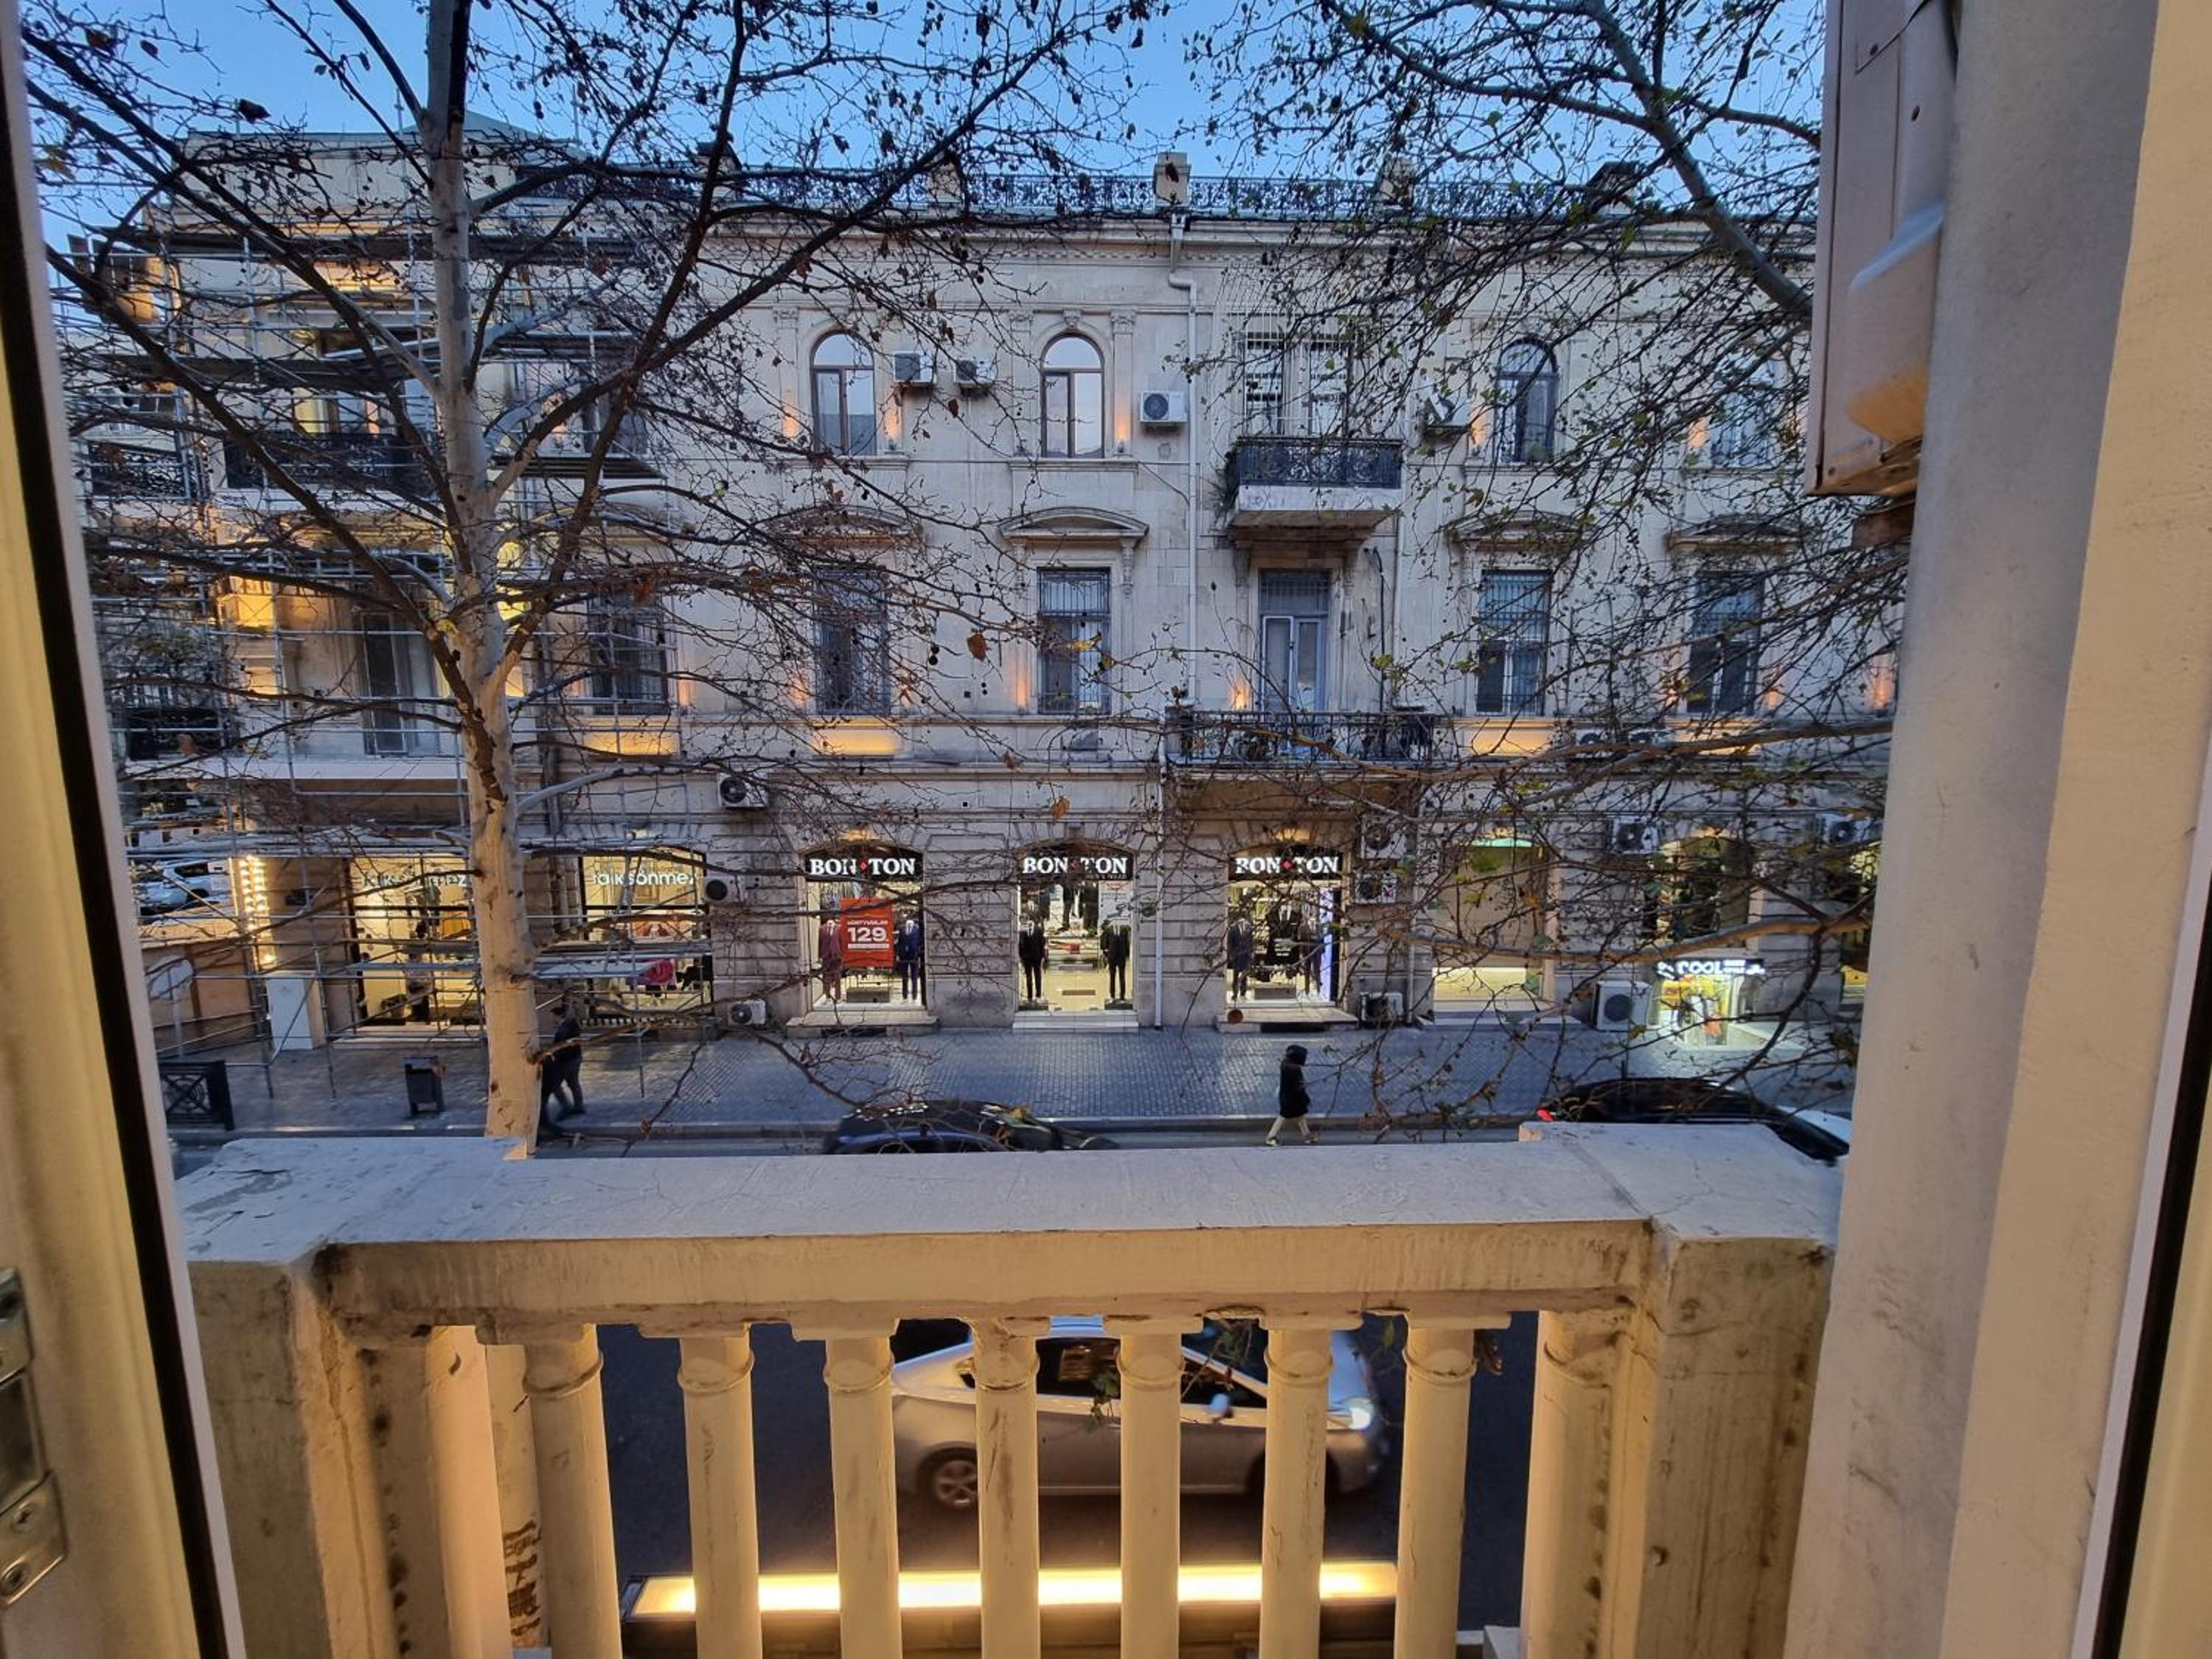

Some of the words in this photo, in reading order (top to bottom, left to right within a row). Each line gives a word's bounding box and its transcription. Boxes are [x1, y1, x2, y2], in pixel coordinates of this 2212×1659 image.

[810, 858, 858, 875] BON
[868, 858, 916, 875] TON
[1023, 857, 1068, 874] BON
[1080, 857, 1127, 874] TON
[1235, 857, 1281, 874] BON
[1294, 856, 1339, 874] TON
[1676, 960, 1722, 975] COOL
